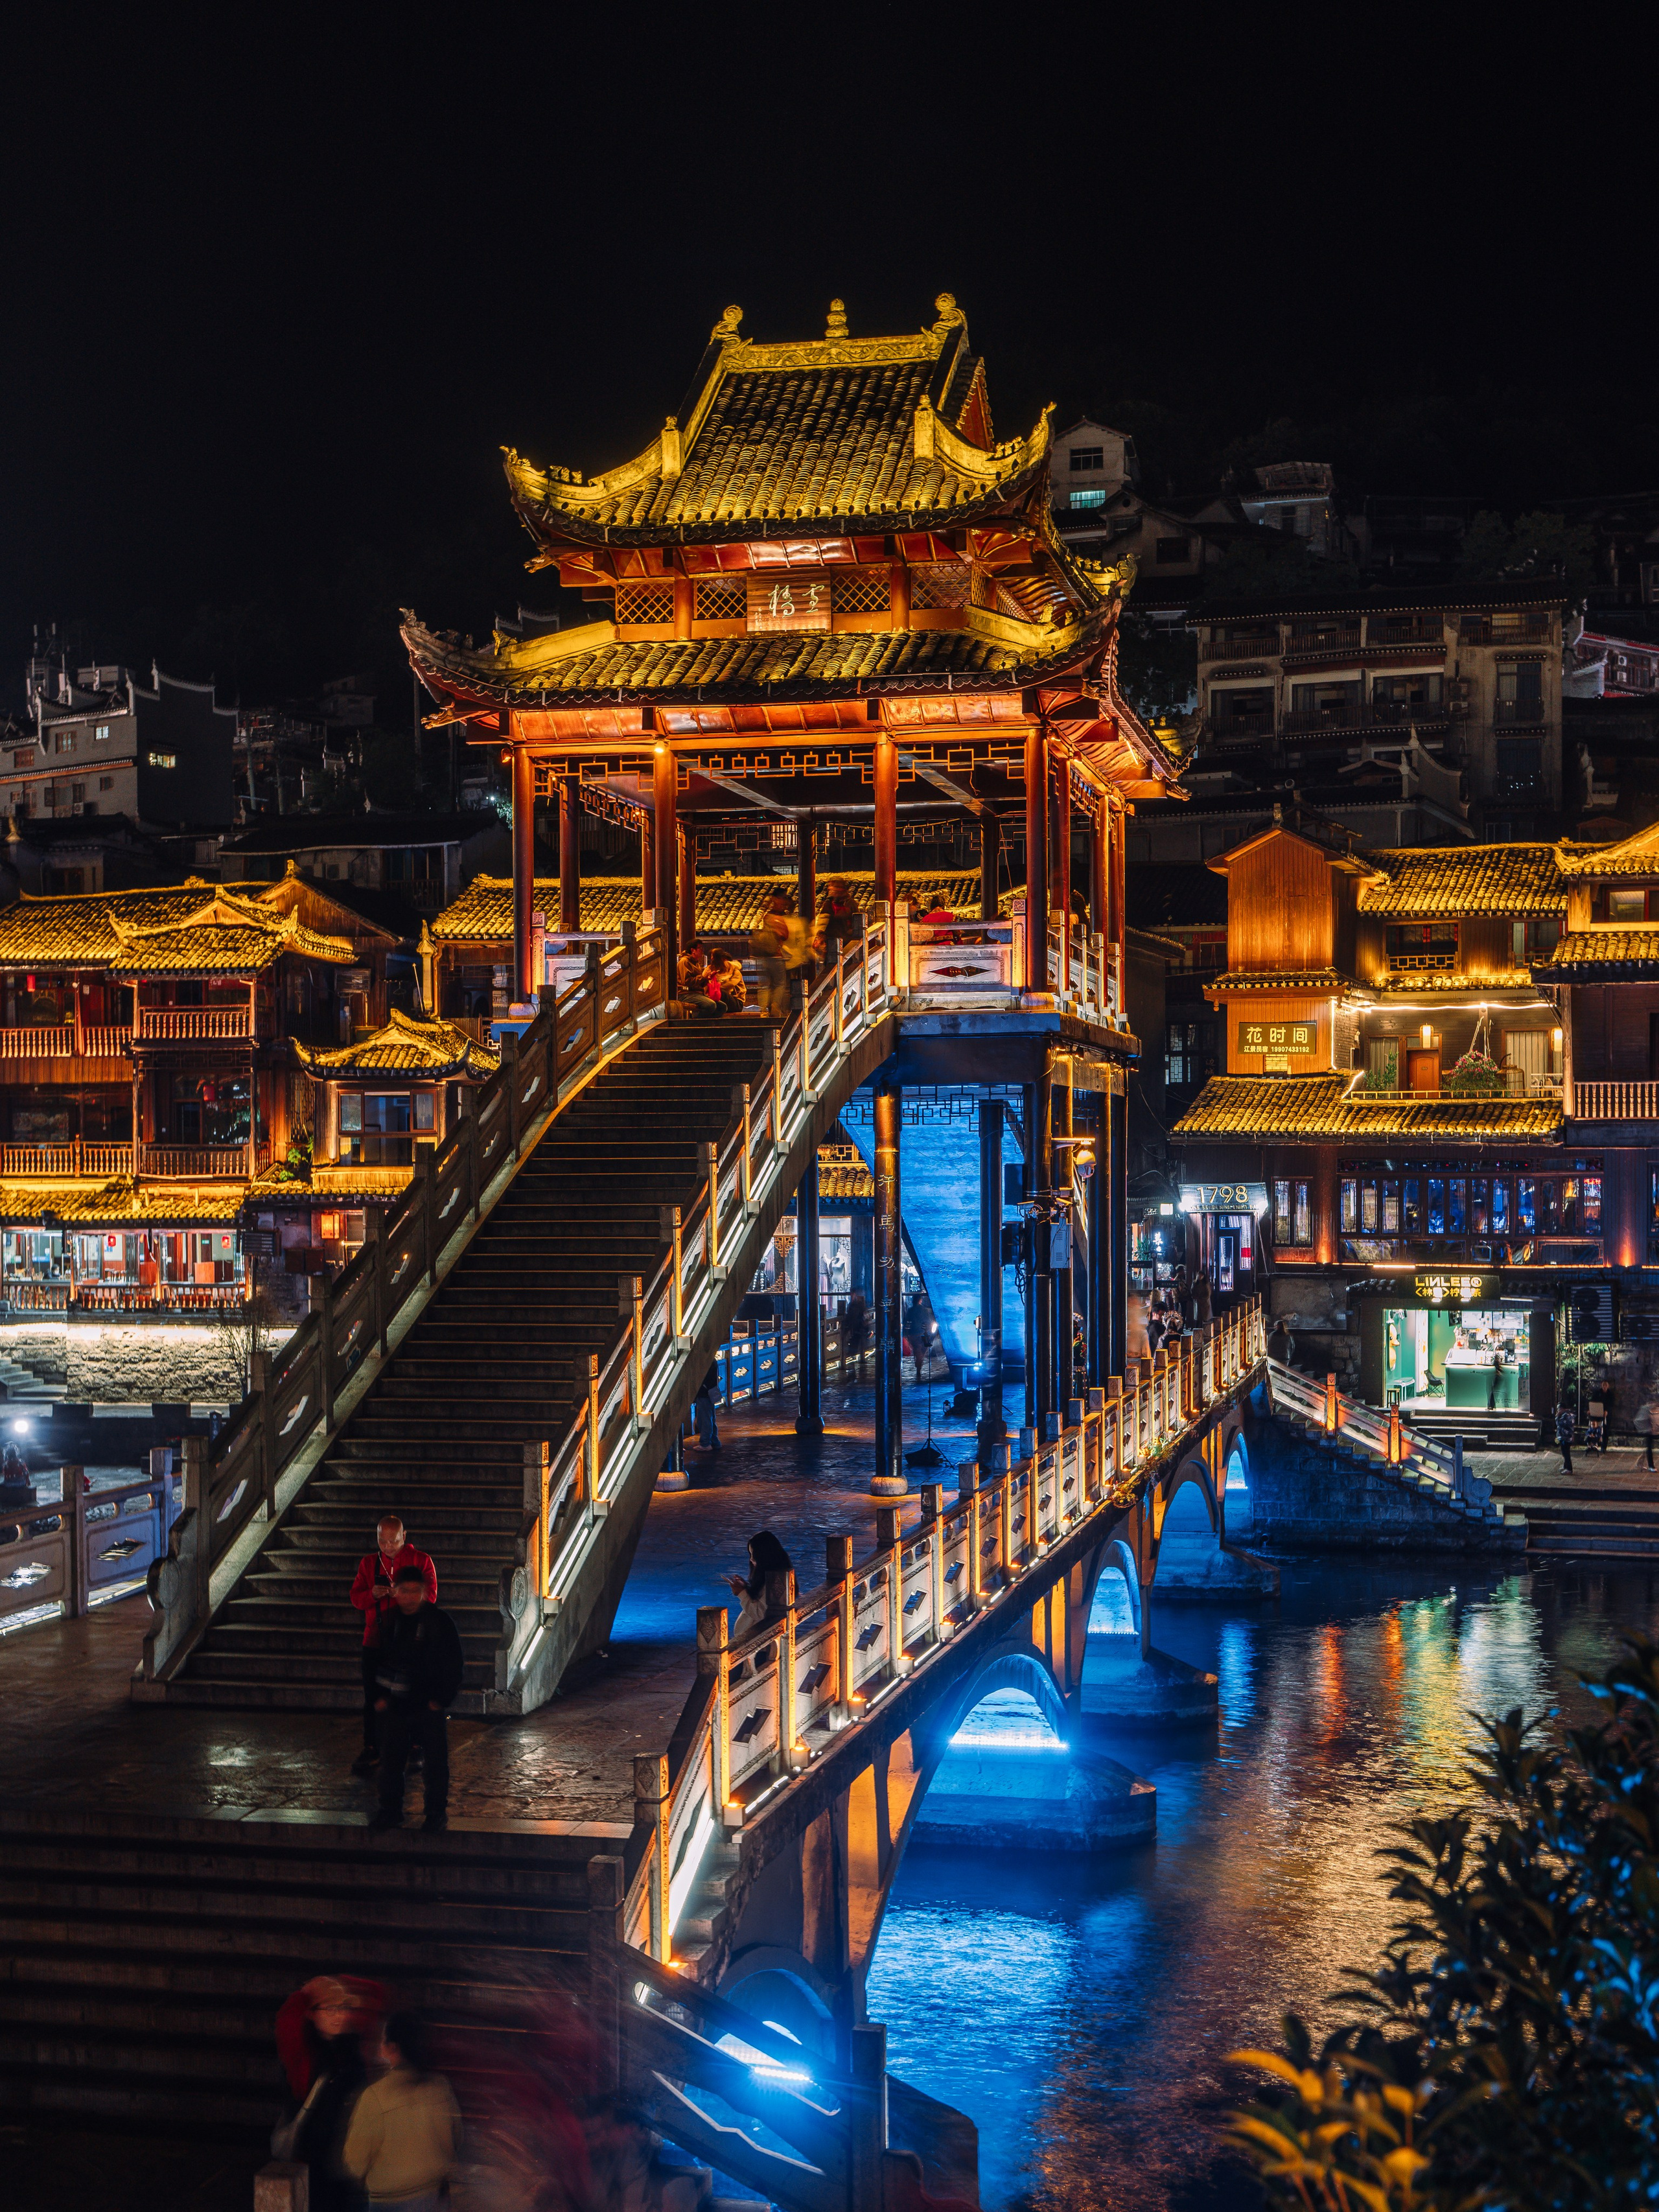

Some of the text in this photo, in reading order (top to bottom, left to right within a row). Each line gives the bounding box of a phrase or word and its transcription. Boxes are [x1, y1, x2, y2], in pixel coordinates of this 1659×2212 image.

[1246, 1026, 1308, 1044] 花时间
[1196, 1185, 1249, 1204] 1798
